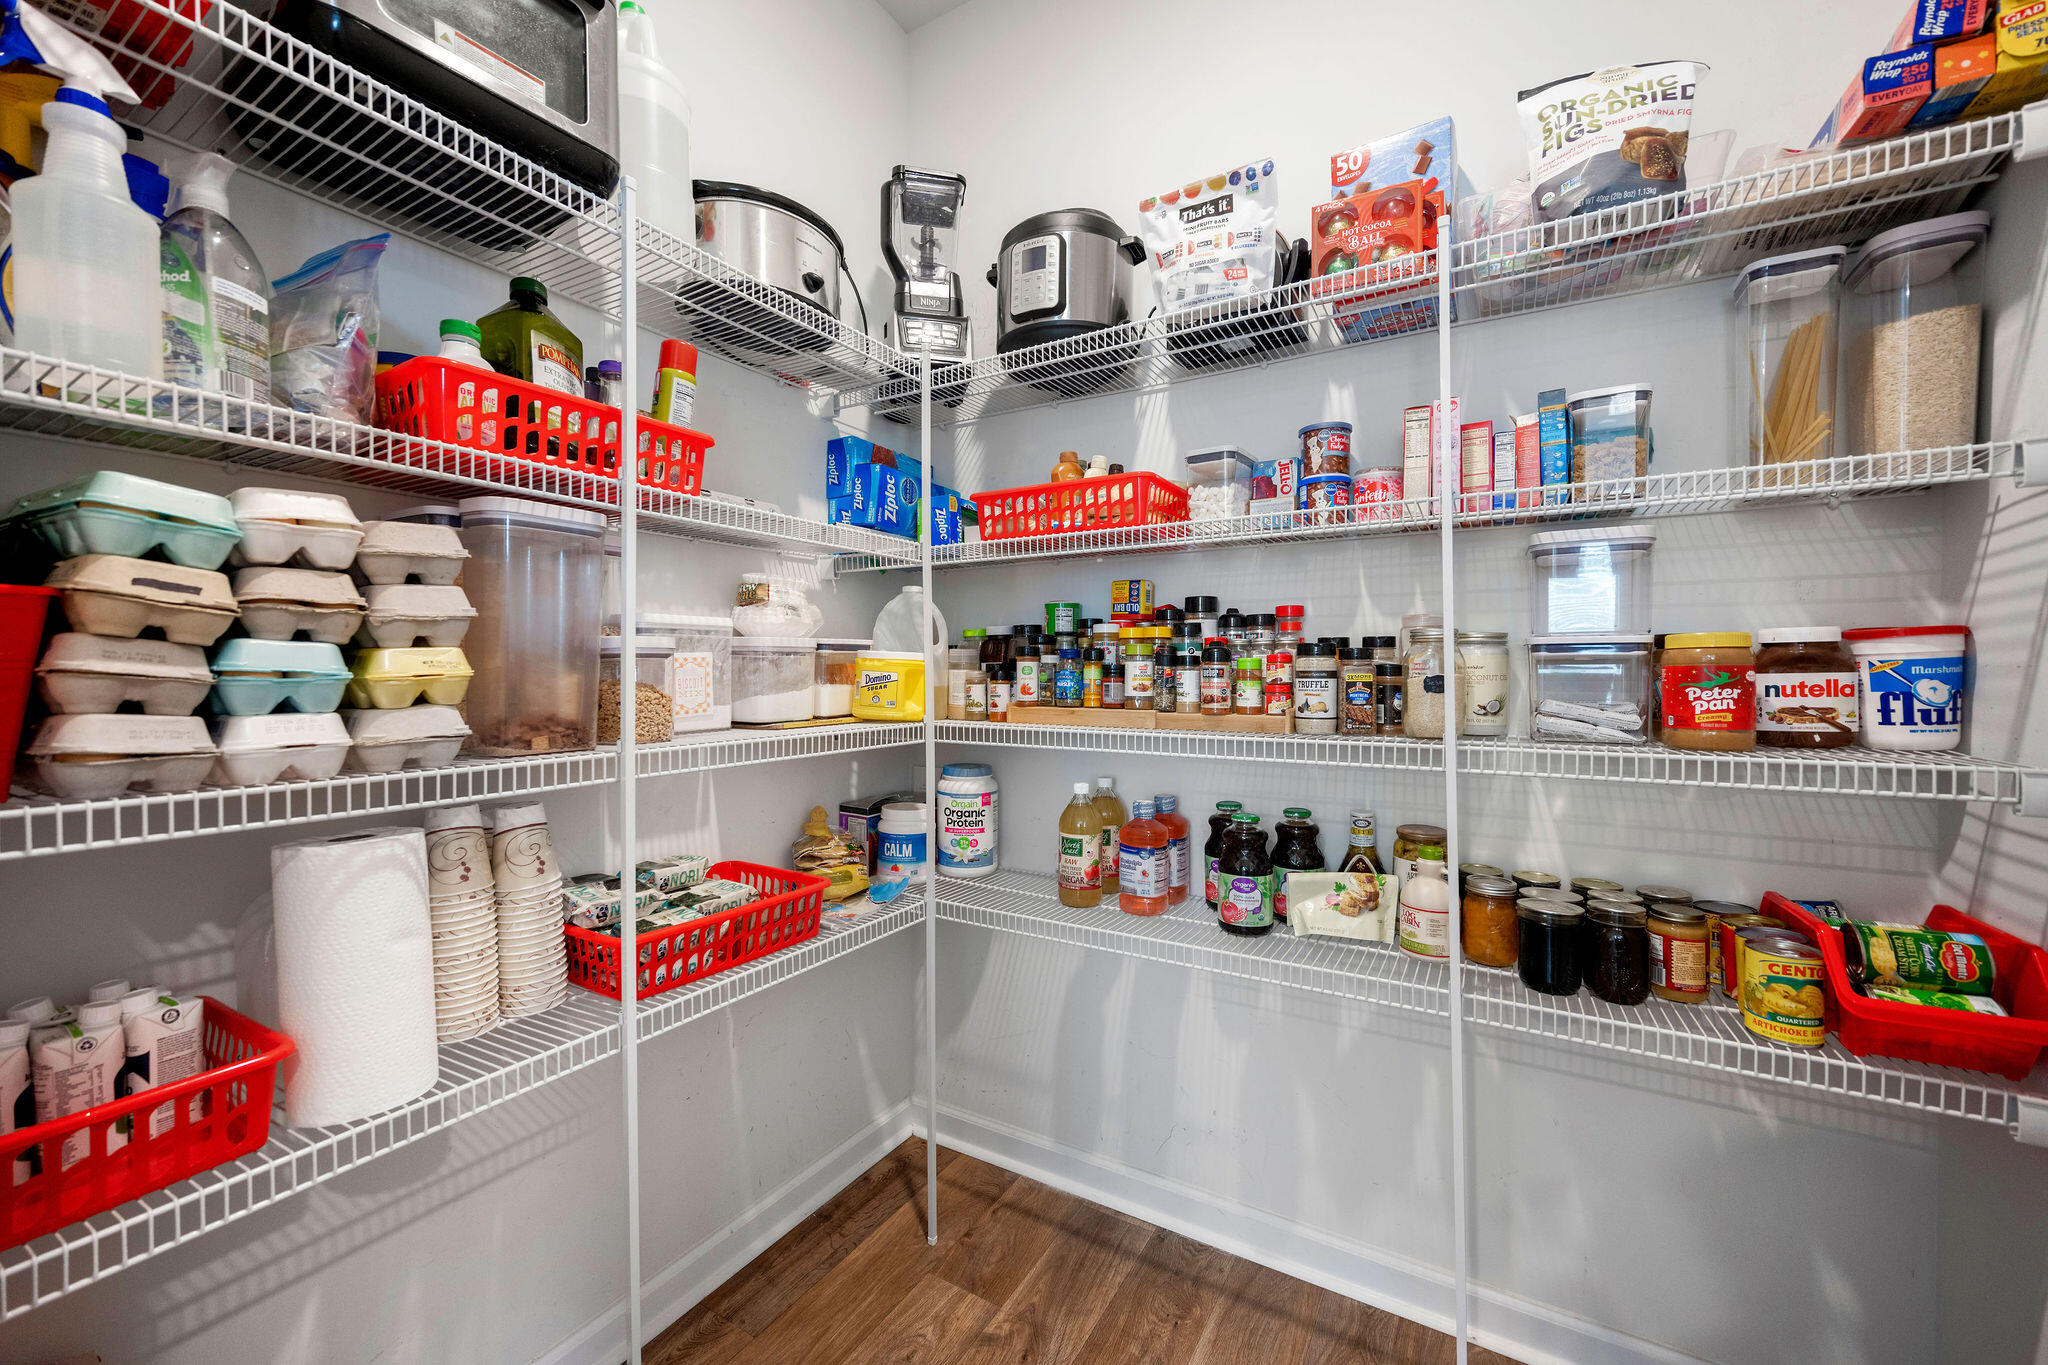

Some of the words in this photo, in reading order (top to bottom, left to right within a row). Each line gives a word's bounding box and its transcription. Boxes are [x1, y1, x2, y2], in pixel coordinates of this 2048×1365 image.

[2003, 4, 2044, 25] GLAD
[1932, 10, 1950, 36] Wrap
[1874, 51, 1929, 71] Reynolds
[1870, 68, 1902, 81] Wrap
[1901, 62, 1929, 77] 250
[1538, 74, 1679, 122] ORGANIC
[1872, 84, 1925, 103] EVERYDAY
[1604, 115, 1634, 126] DRIED
[1636, 110, 1675, 119] SMYRNA
[1542, 118, 1603, 158] FIGS
[1336, 150, 1363, 177] 50
[1337, 170, 1361, 183] ENVELOPES
[1181, 204, 1215, 221] That's
[1322, 200, 1344, 212] PACK
[1196, 220, 1213, 229] FRUIT
[1214, 217, 1229, 225] BARS
[1342, 226, 1361, 237] HOT
[1361, 219, 1392, 233] COCOA
[1348, 232, 1385, 251] BALL
[1227, 269, 1238, 280] 24
[920, 297, 942, 308] NINJA
[1330, 442, 1344, 450] Fudge
[828, 453, 838, 485] Ziploc
[1278, 460, 1292, 495] JELL-O
[854, 478, 864, 510] Ziploc
[884, 474, 899, 524] Ziploc
[935, 508, 948, 540] Ziploc
[1113, 603, 1125, 611] BAY
[1126, 603, 1140, 612] OLD
[678, 677, 703, 689] BISCUIT
[865, 674, 892, 685] Domino
[1298, 680, 1329, 689] TRUFFLE
[678, 689, 704, 698] MIX
[867, 684, 888, 692] SUGAR
[1685, 686, 1741, 701] Peter
[1765, 679, 1855, 698] nutella
[1692, 698, 1736, 715] Pan
[1697, 714, 1728, 722] Creamy
[951, 799, 978, 810] Orgain
[944, 807, 986, 819] Organic
[946, 817, 984, 828] Protein
[884, 842, 912, 857] CALM
[1063, 838, 1082, 849] North
[670, 868, 699, 888] NORI
[1234, 881, 1255, 889] Organic
[1402, 909, 1416, 920] LOG
[1892, 935, 1906, 955] CREAM
[1905, 936, 1918, 957] SWEET
[1898, 955, 1909, 977] STYLE
[1909, 957, 1919, 978] CORN
[1951, 943, 1960, 954] Del
[1956, 955, 1968, 981] Monte
[1768, 963, 1825, 979] CENTO
[1751, 1018, 1809, 1038] ARTICHOKE
[1776, 1015, 1820, 1026] QUARTERED
